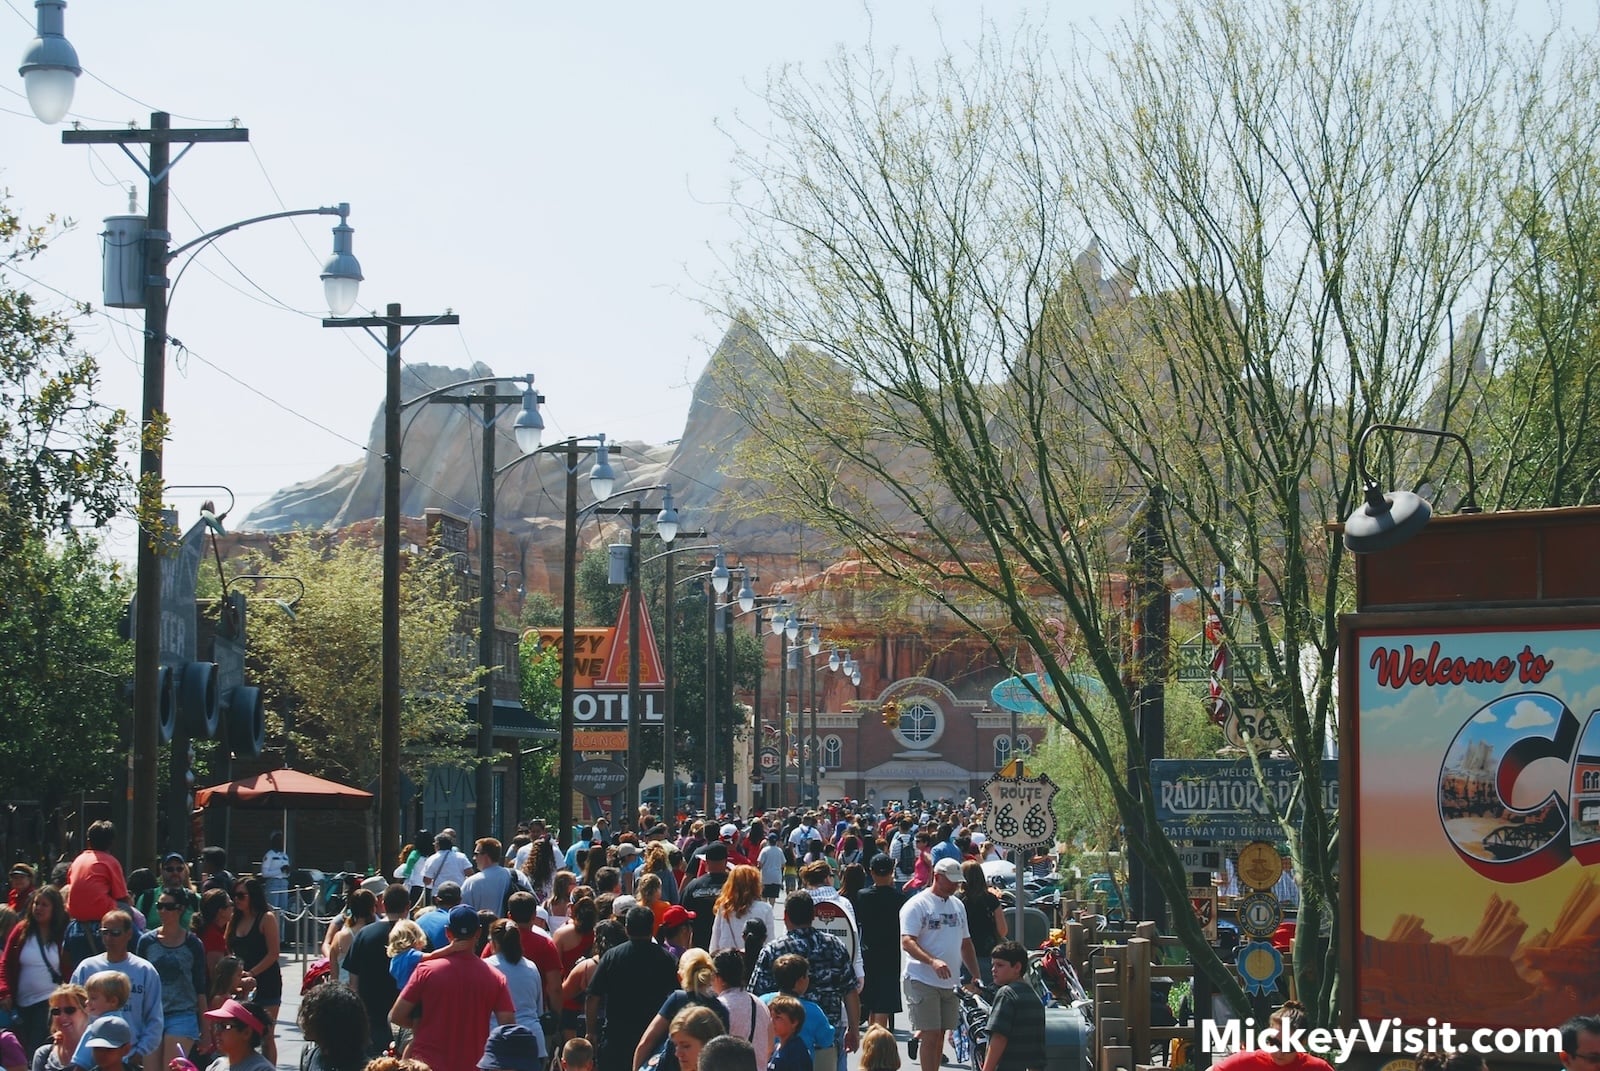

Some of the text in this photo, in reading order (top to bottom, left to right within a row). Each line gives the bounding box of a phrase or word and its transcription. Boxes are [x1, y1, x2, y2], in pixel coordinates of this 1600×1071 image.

[574, 658, 604, 676] NE
[1370, 641, 1554, 689] Welcome to
[573, 693, 664, 720] OTL
[1237, 714, 1277, 740] 66
[573, 736, 625, 747] ACANCY
[1000, 787, 1042, 799] ROUTE
[1161, 780, 1268, 814] RADIATOR
[995, 803, 1047, 838] 66
[1163, 826, 1217, 837] GATEWAY
[1222, 826, 1236, 837] TO
[1255, 907, 1268, 922] L
